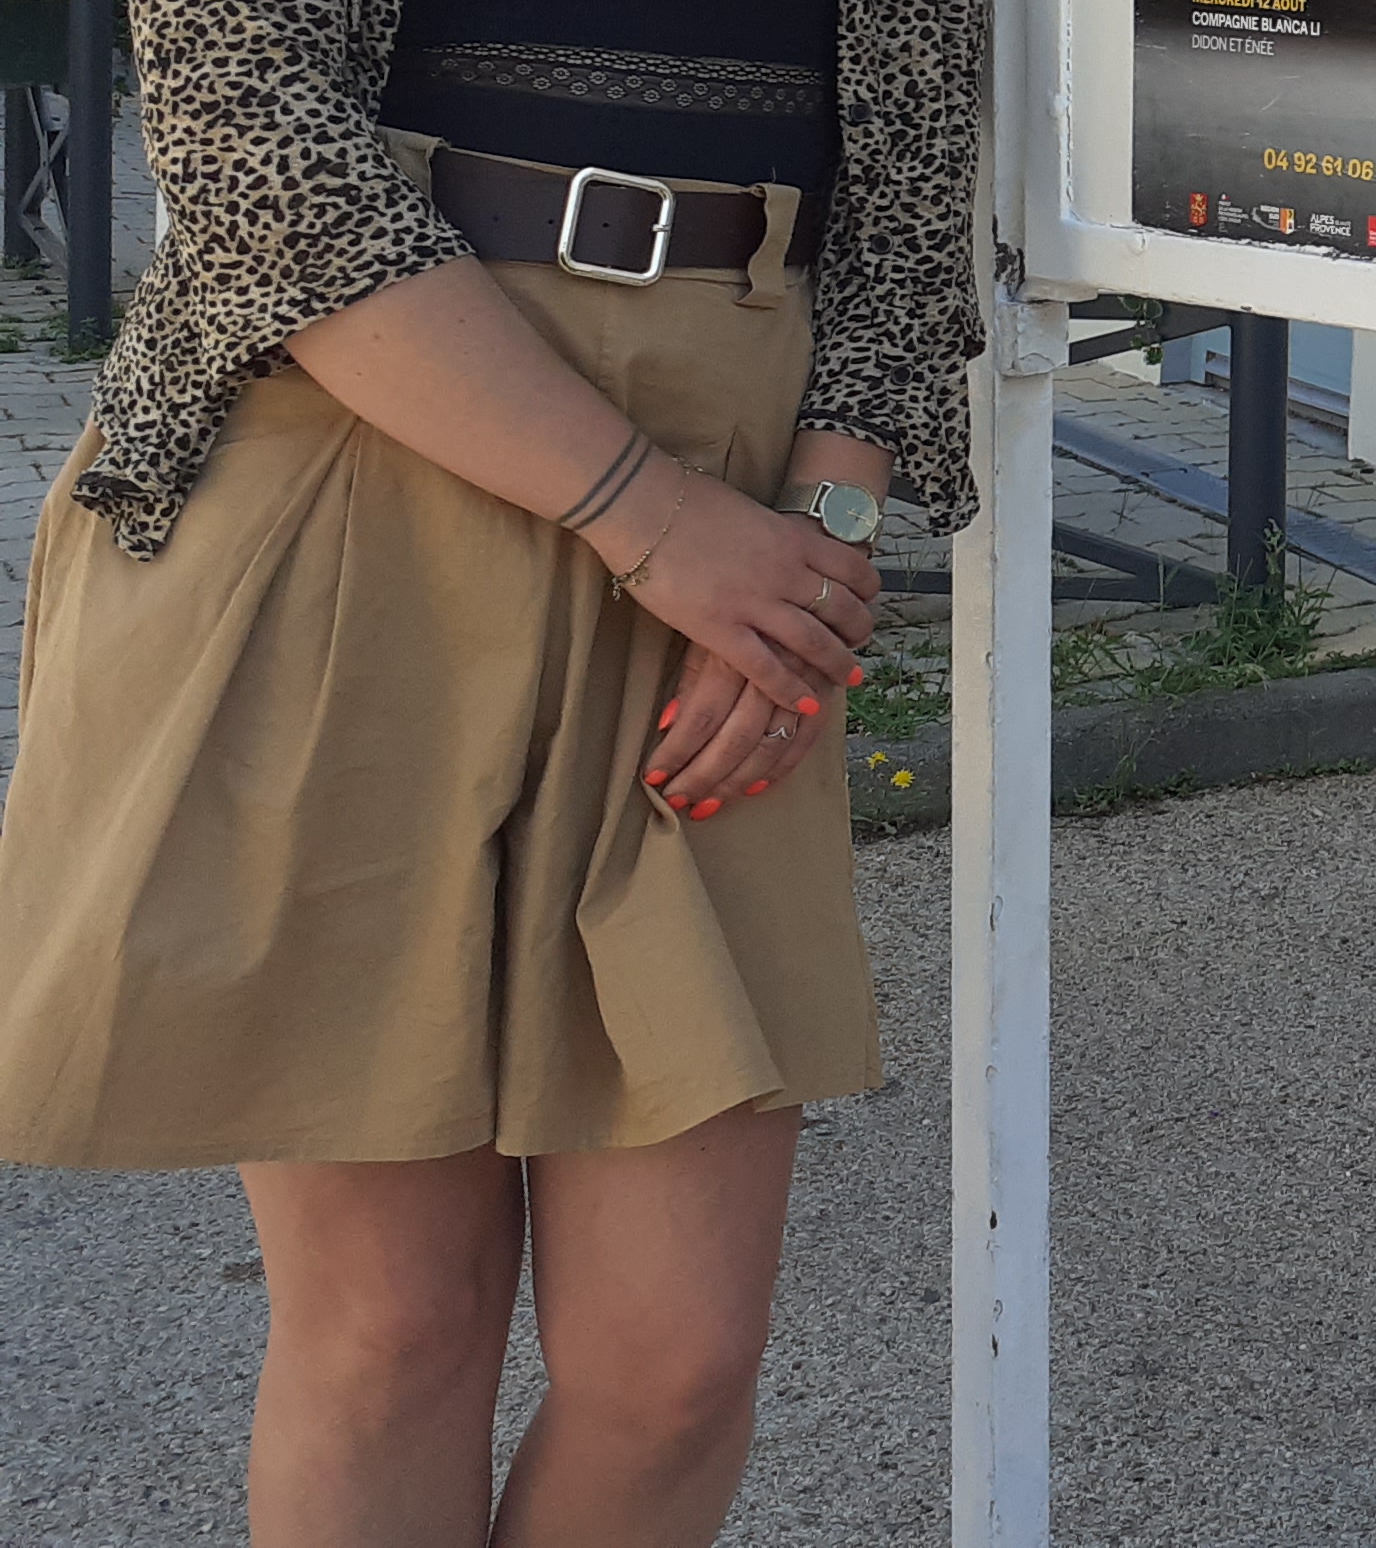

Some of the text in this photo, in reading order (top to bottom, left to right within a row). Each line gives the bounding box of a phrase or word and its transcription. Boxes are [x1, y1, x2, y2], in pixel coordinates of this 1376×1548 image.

[1192, 11, 1321, 36] COMPAGNIE BLANCA LI
[1192, 34, 1275, 56] DIDON ET ÉNÉE
[1263, 148, 1289, 171] 04
[1293, 152, 1318, 175] 92
[1321, 155, 1343, 176] 61
[1347, 158, 1374, 181] 06
[1310, 214, 1334, 224] ALPES
[1310, 223, 1351, 236] PROVENCE
